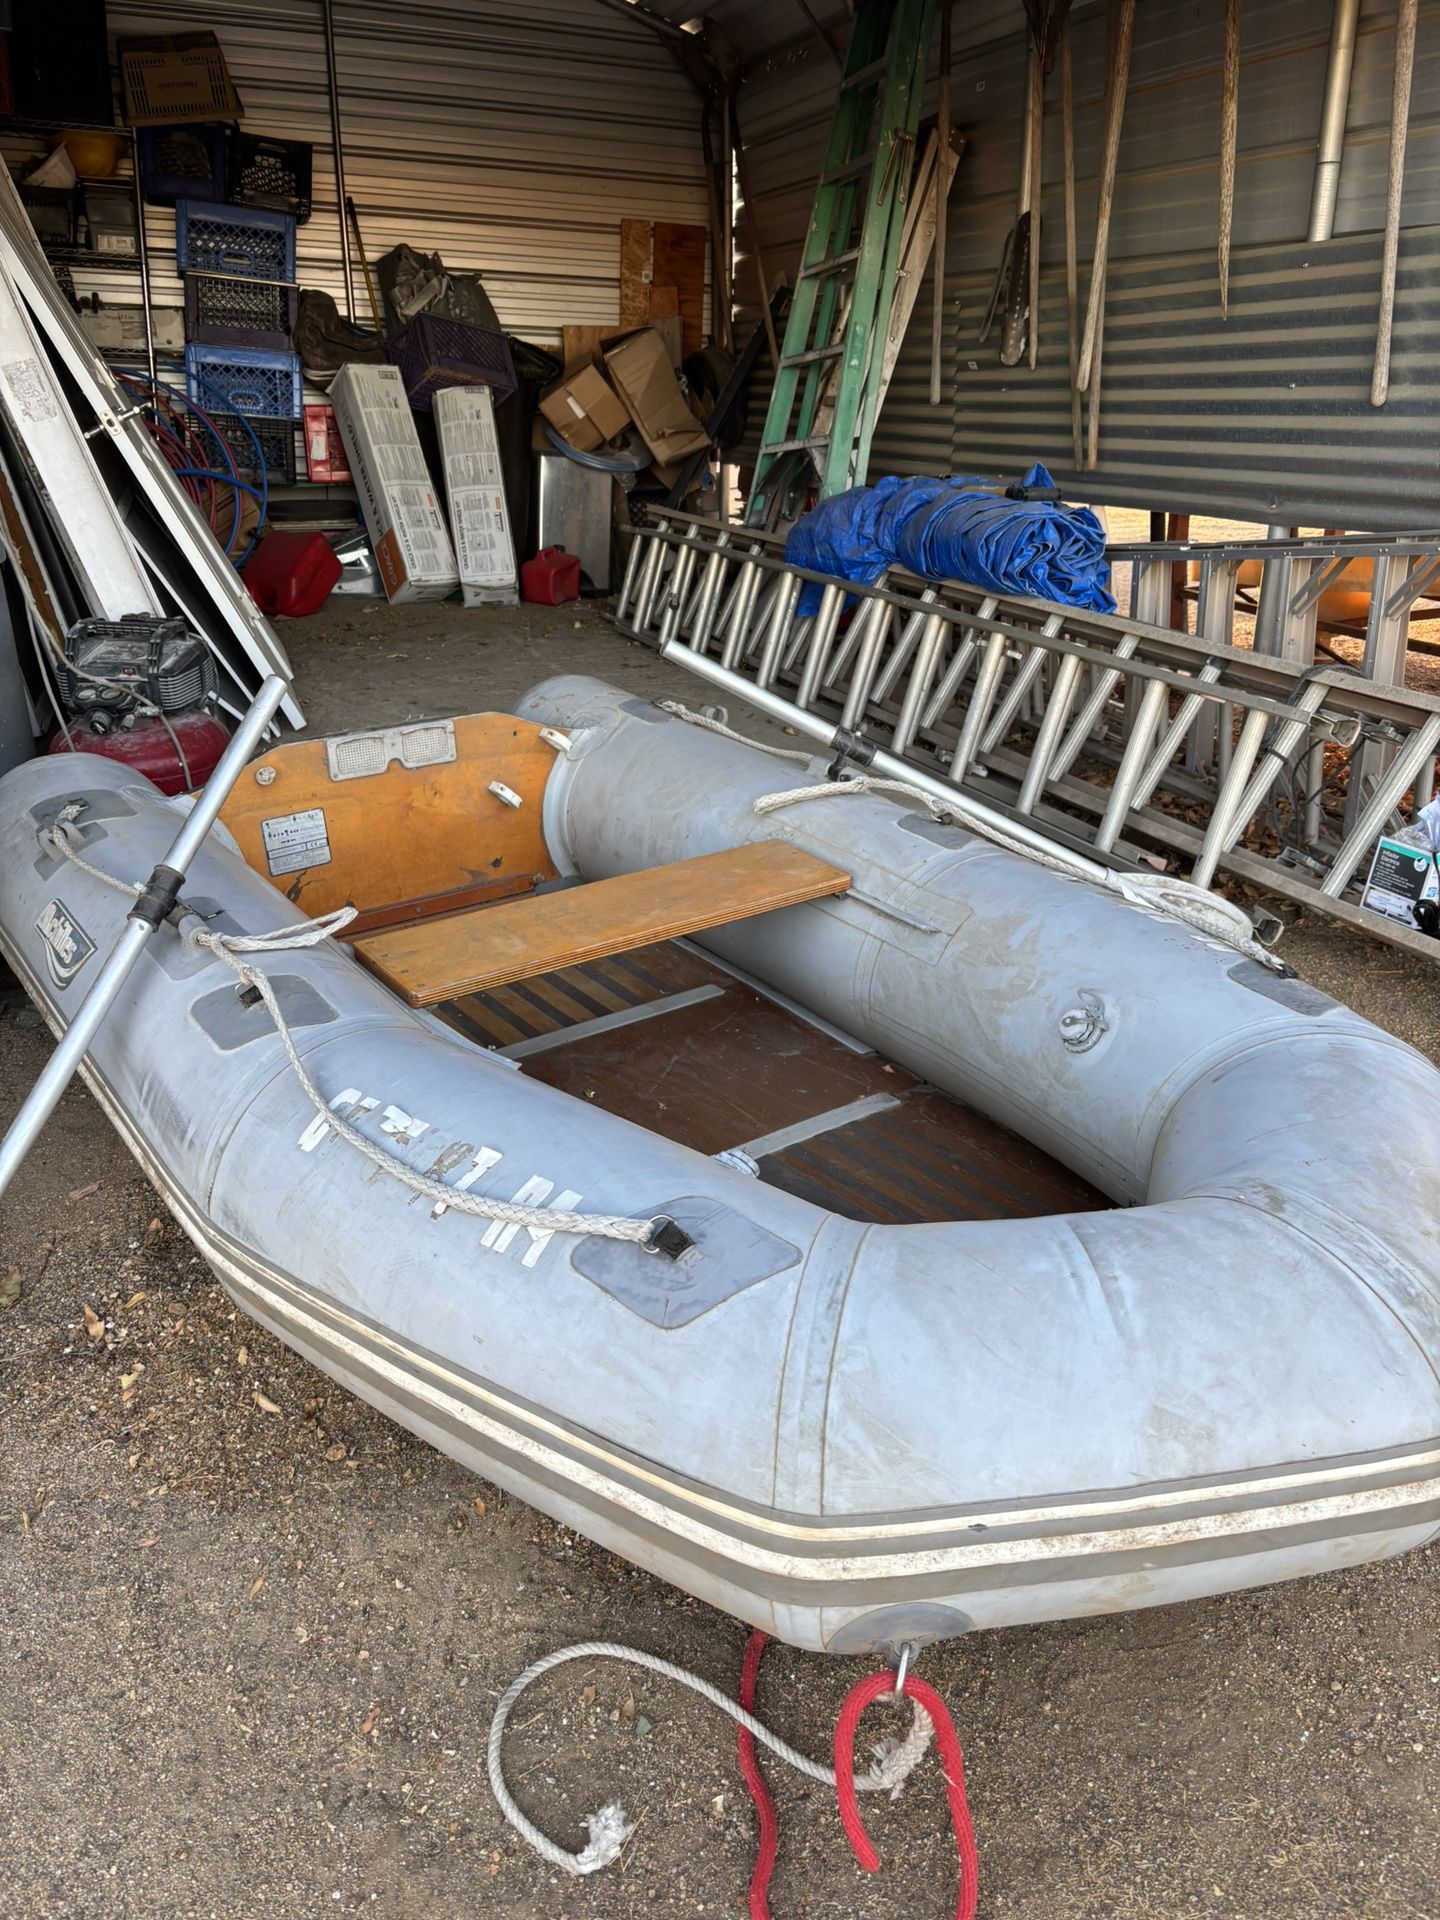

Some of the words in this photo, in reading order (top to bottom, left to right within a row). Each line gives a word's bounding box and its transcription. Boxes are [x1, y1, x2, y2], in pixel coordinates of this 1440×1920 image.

[347, 424, 362, 465] SHIELD
[360, 464, 376, 504] WATER
[375, 517, 384, 537] ICE
[380, 538, 397, 586] GRACE
[37, 904, 78, 965] Achilles
